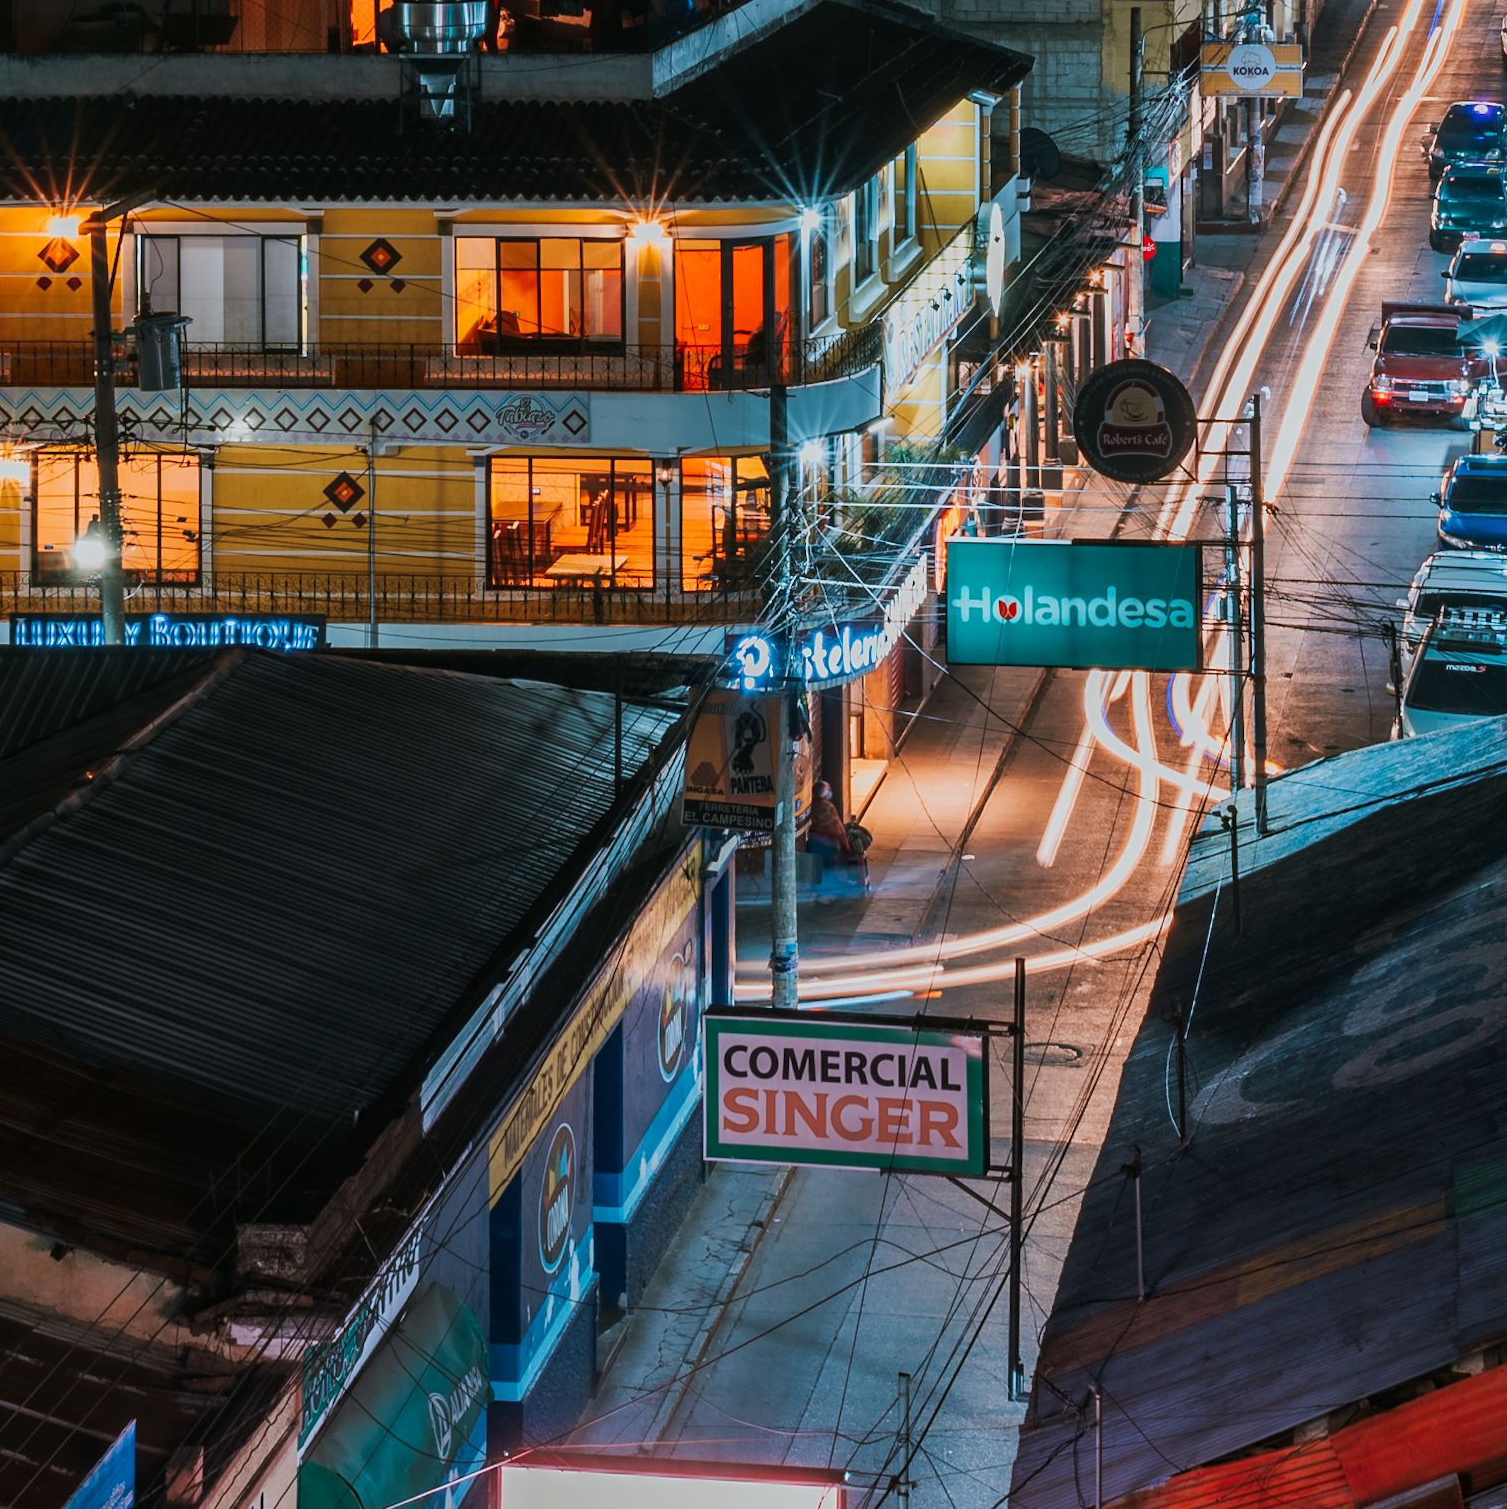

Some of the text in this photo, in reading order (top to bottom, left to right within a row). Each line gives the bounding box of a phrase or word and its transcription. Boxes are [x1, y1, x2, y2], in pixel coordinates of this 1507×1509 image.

[1233, 66, 1270, 76] KOKOA
[952, 585, 1194, 629] Holandesa
[731, 775, 774, 795] PANTERA
[684, 811, 774, 830] EL CAMPESINO
[723, 1044, 962, 1092] COMERCIAL
[723, 1086, 963, 1149] SINGER
